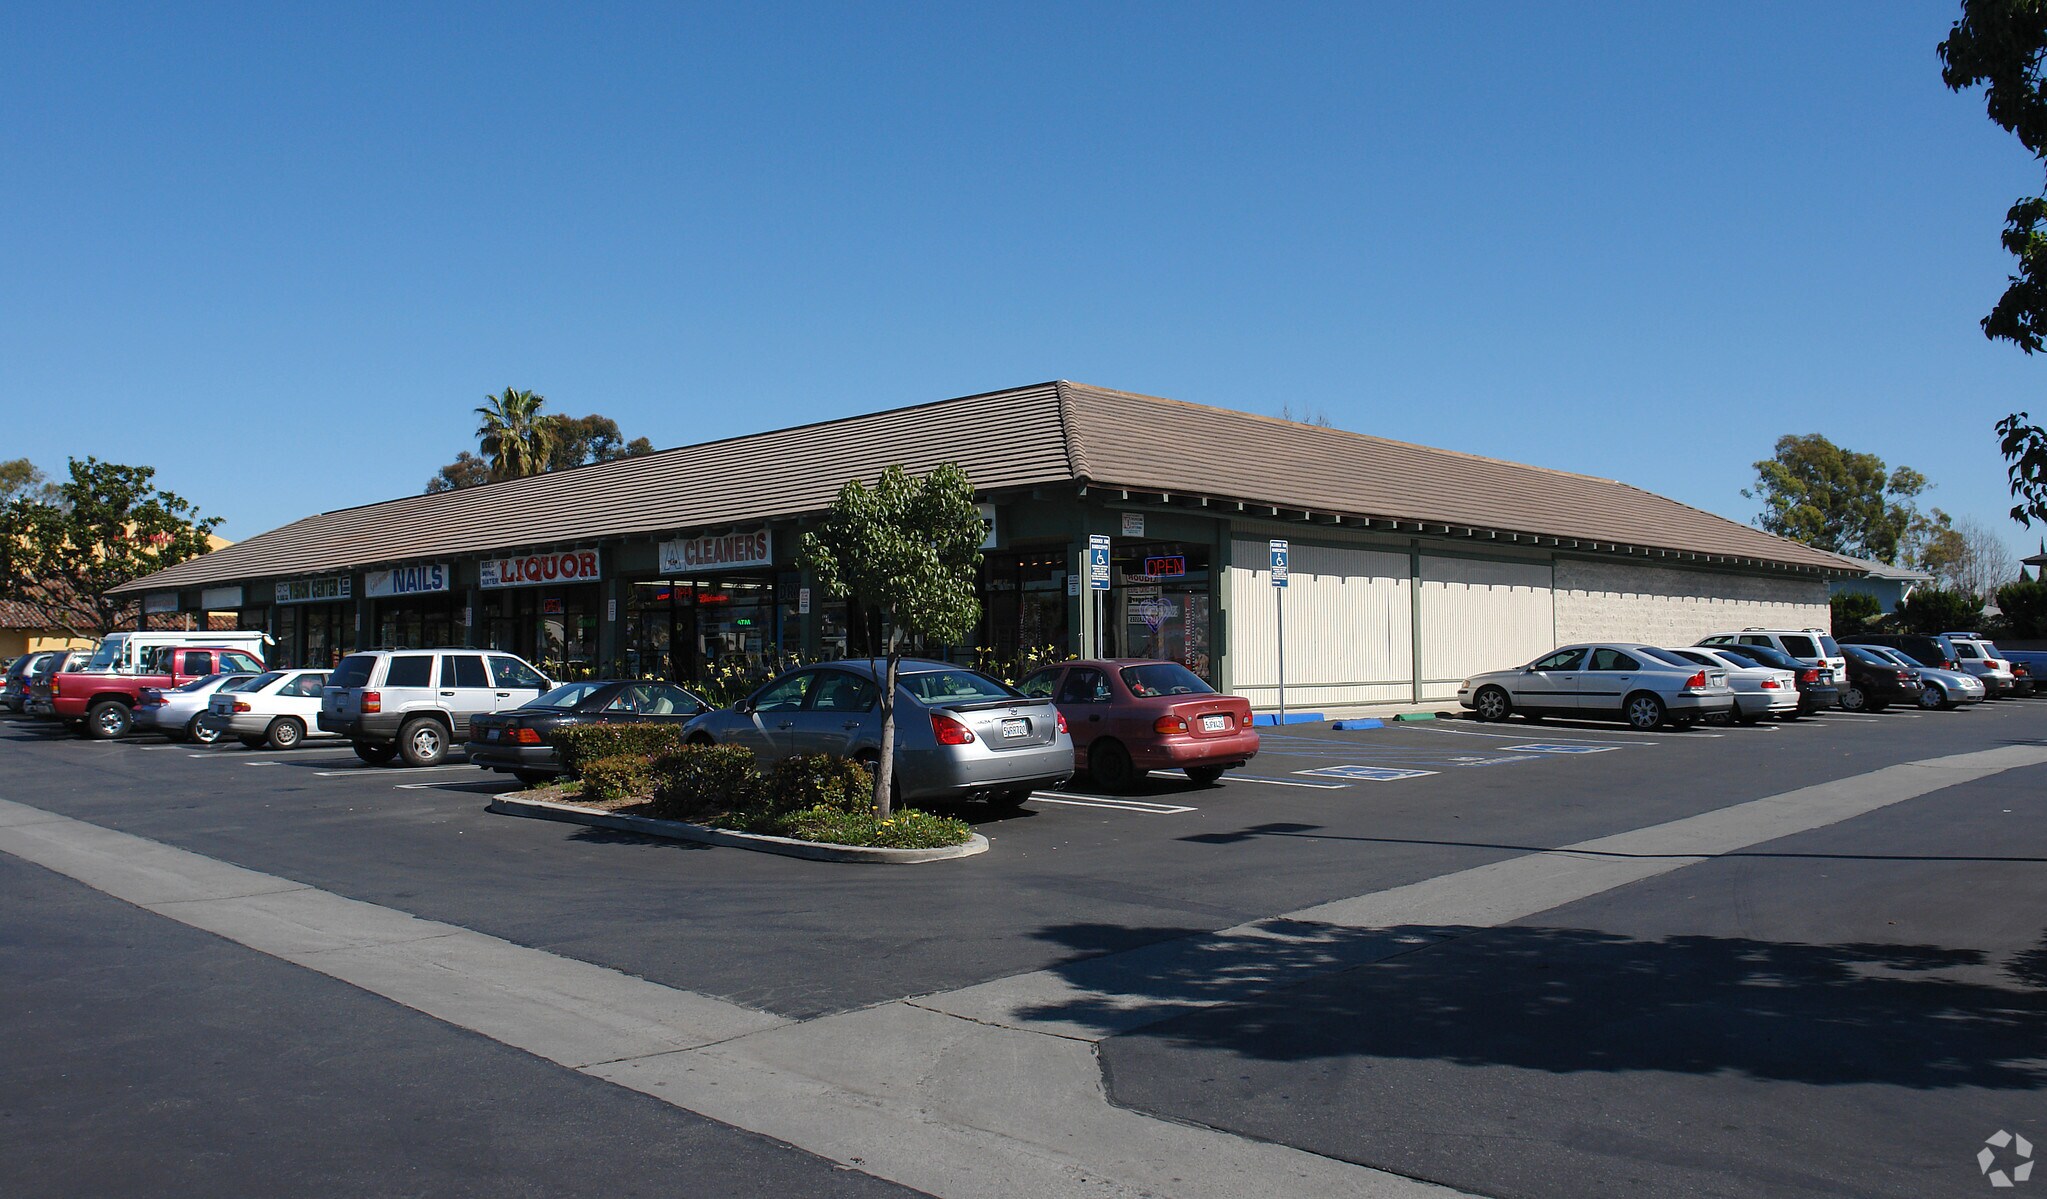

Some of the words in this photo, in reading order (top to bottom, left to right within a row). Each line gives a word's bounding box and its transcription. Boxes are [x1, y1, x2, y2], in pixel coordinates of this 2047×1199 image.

[684, 532, 767, 566] CLEANERS
[392, 564, 443, 593] NAILS
[500, 552, 599, 583] LIQUOR
[1147, 558, 1183, 577] OPEN
[311, 577, 339, 599] CENTER
[481, 578, 499, 586] WATER
